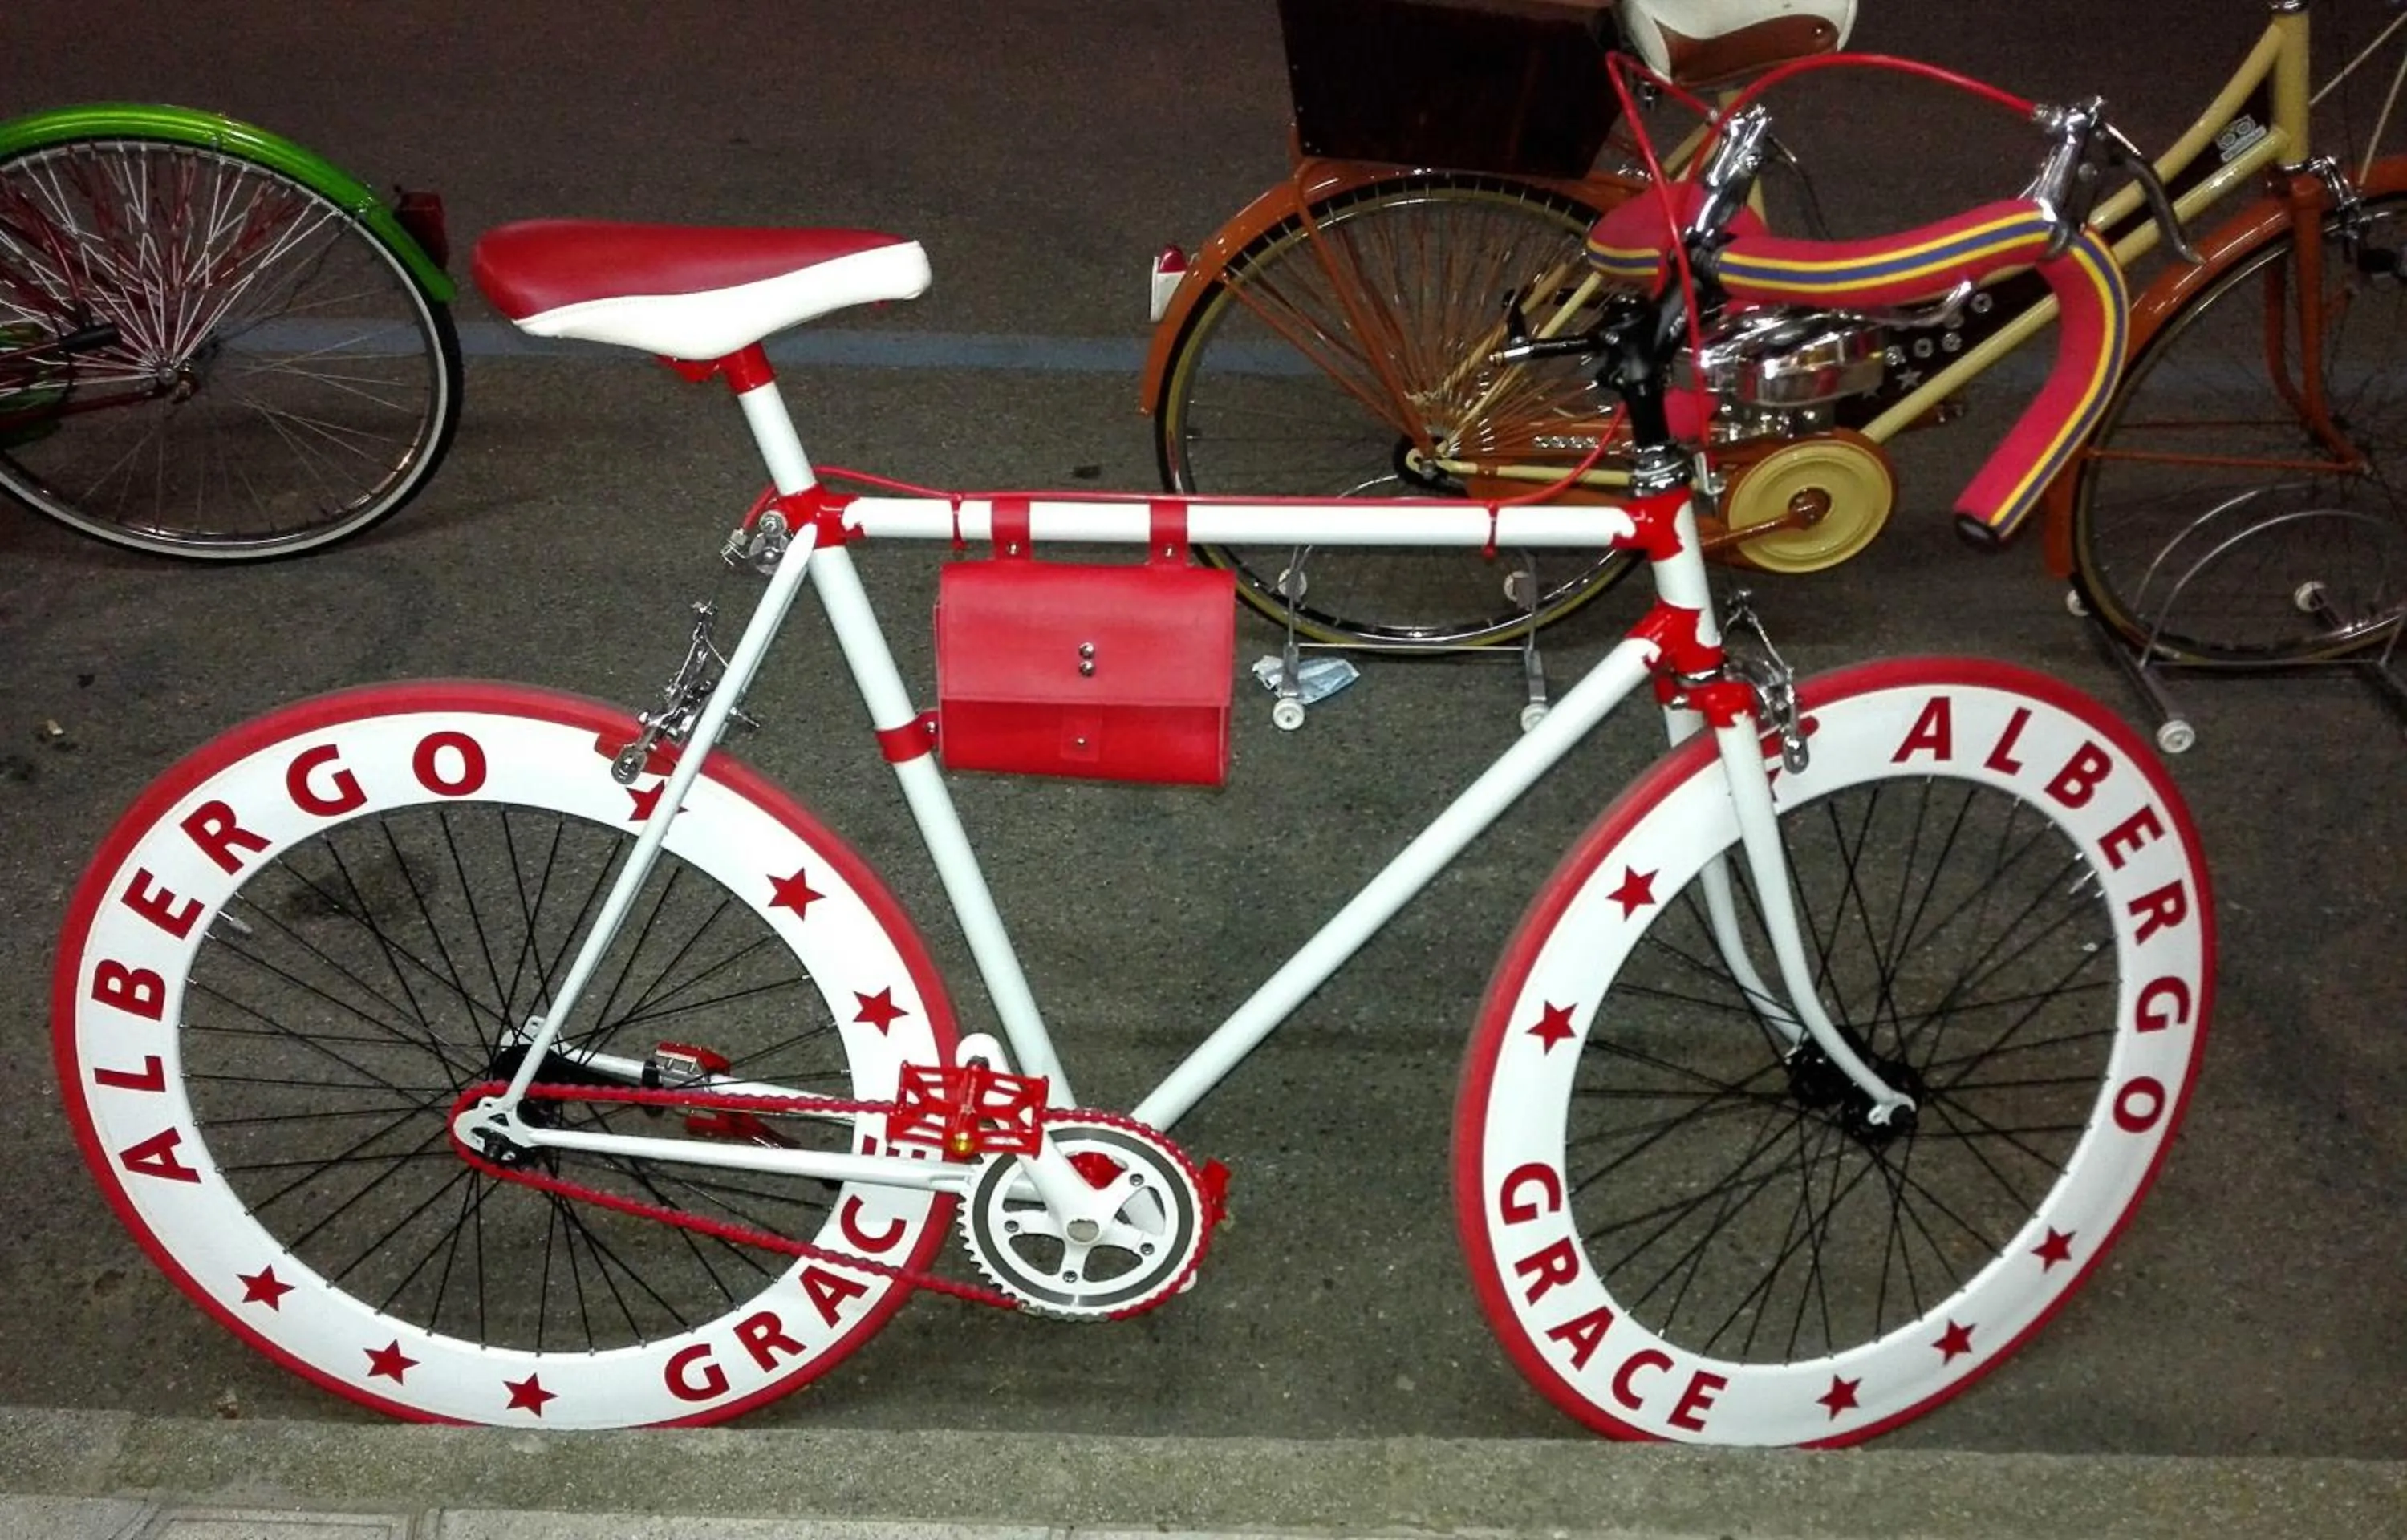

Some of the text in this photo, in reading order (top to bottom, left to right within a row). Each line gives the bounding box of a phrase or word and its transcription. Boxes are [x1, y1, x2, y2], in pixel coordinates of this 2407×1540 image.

[92, 731, 486, 1183] ALBERGO
[1891, 696, 2191, 1133] ALBERGO
[1500, 1162, 1728, 1433] GRACE
